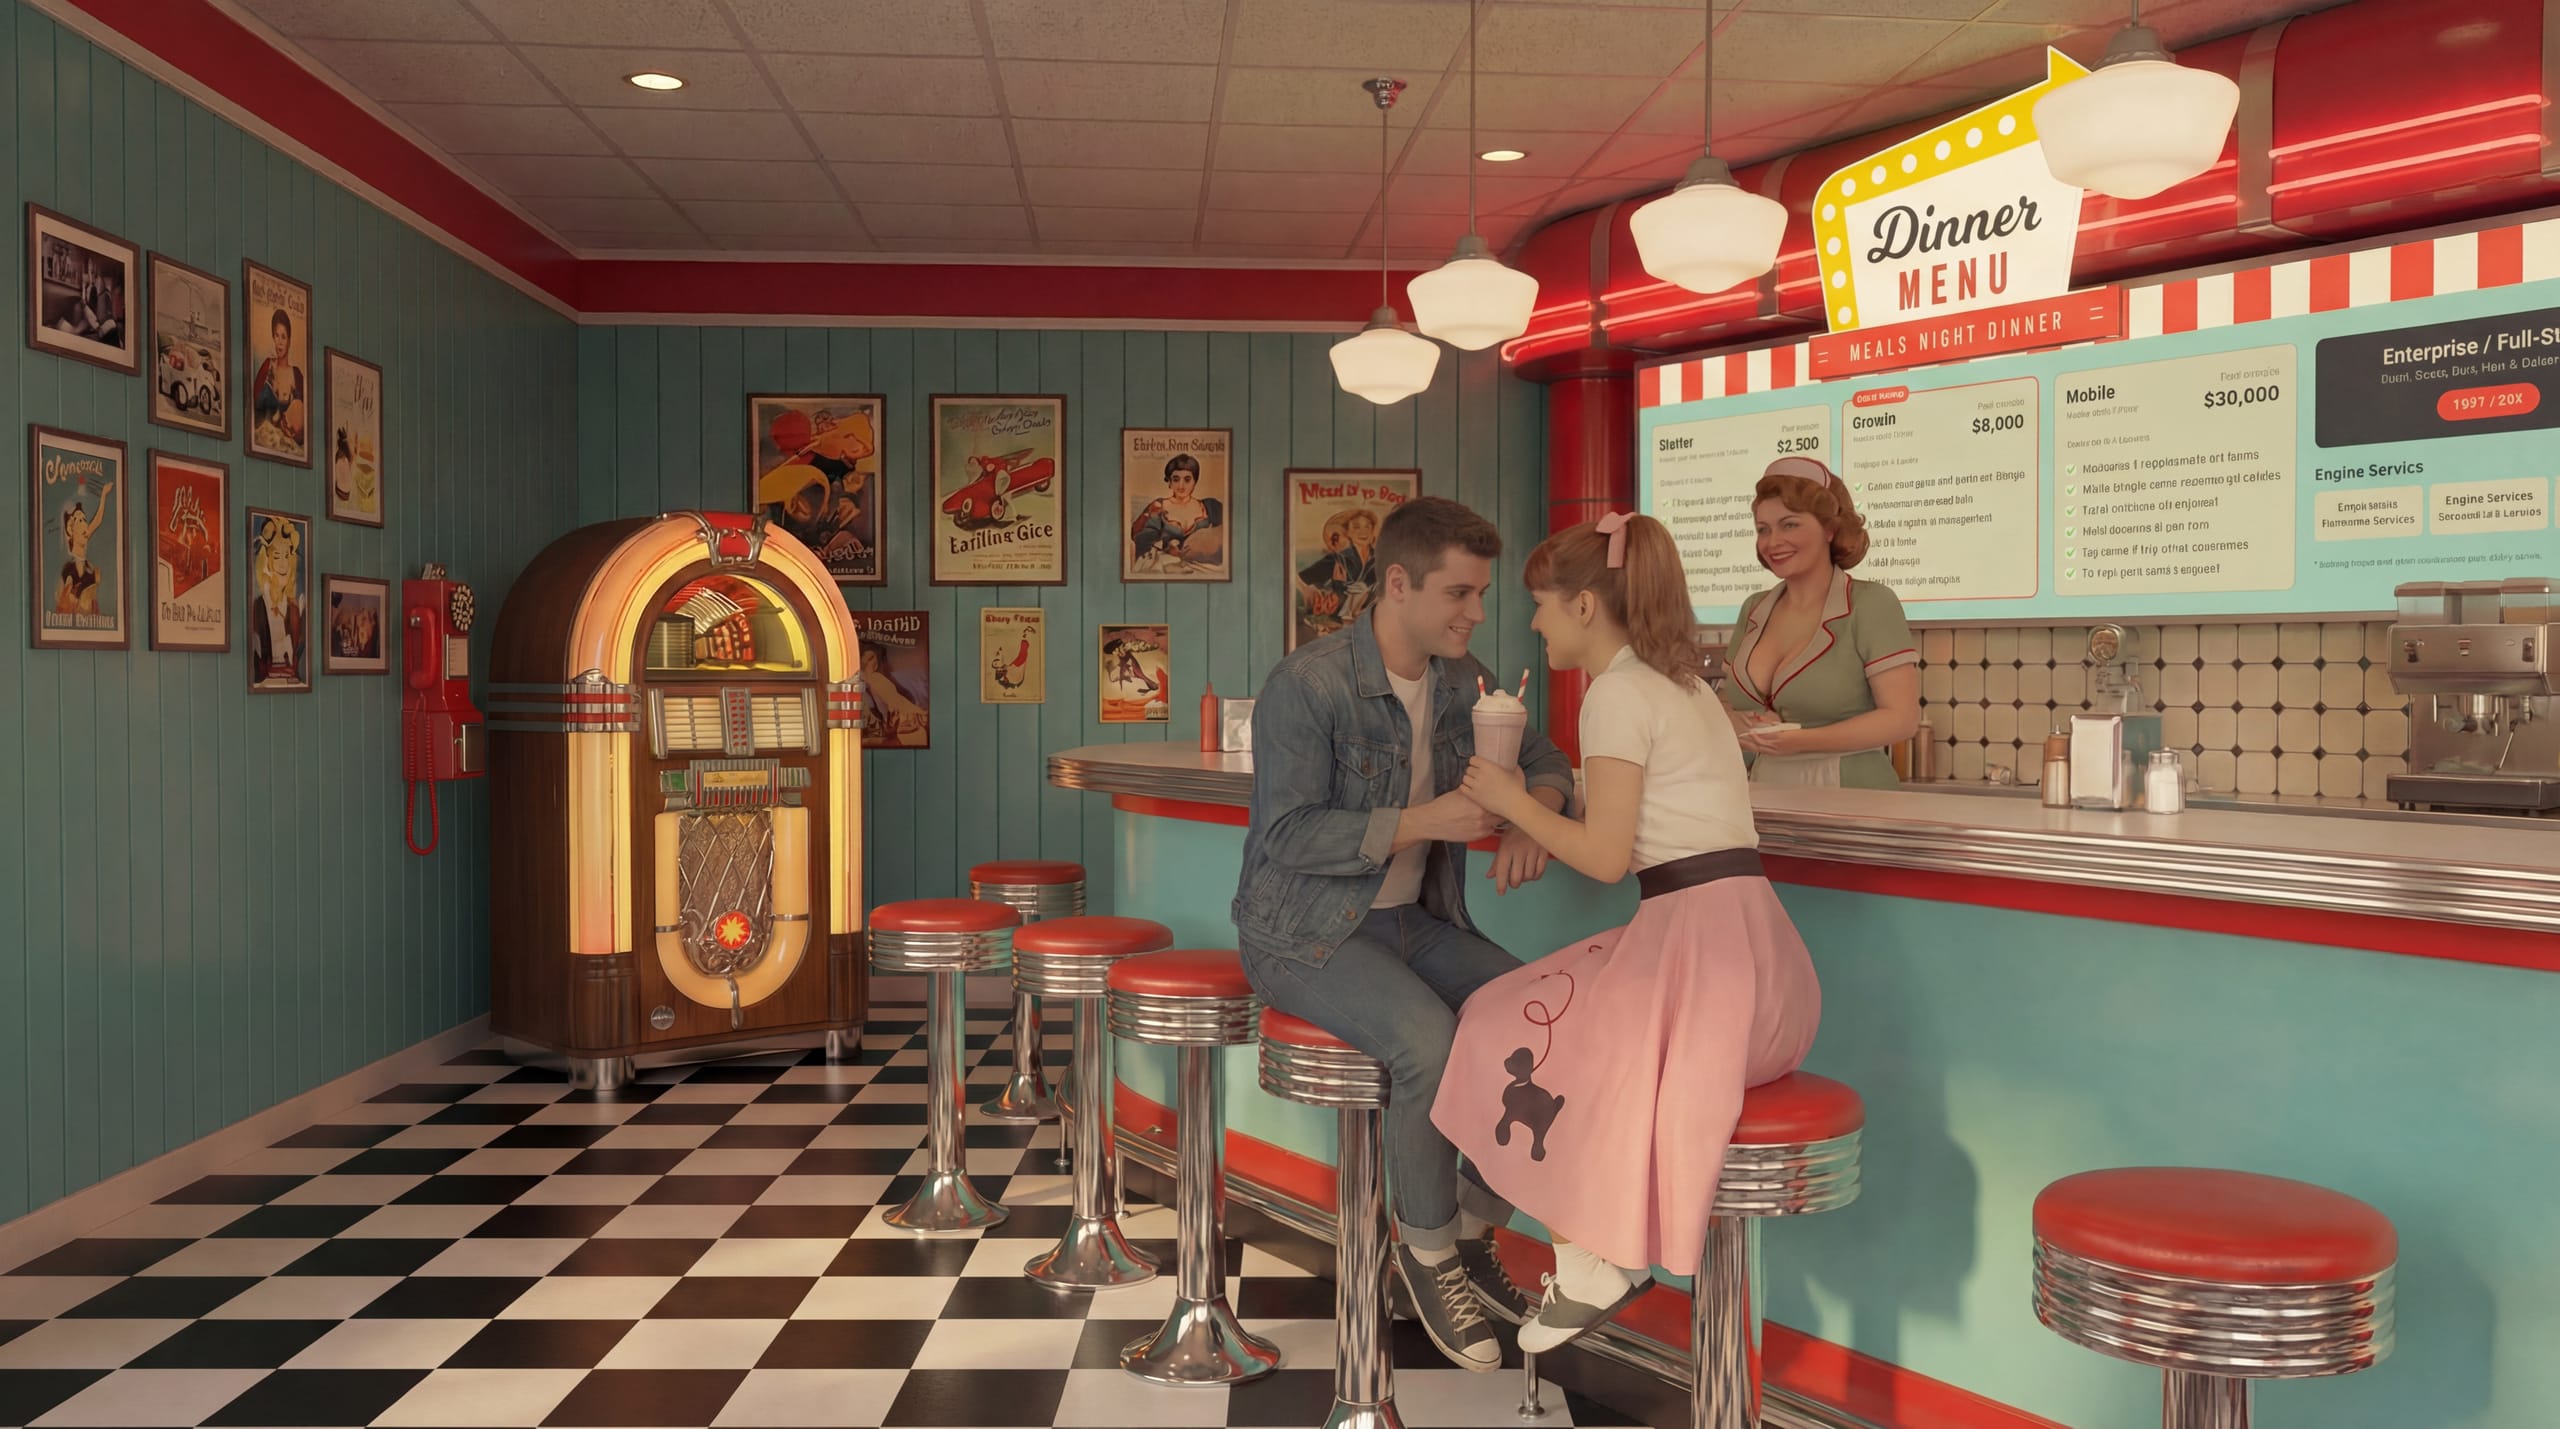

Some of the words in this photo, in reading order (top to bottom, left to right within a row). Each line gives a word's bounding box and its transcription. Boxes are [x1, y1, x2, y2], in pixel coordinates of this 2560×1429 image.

[1867, 195, 2042, 264] Dinner
[1898, 251, 2008, 311] MENU
[1849, 334, 1908, 362] MEALS
[1919, 323, 1976, 350] NIGHT
[1987, 311, 2063, 341] DINNER
[2383, 339, 2479, 366] Enterprise
[2483, 334, 2492, 355] /
[2066, 384, 2116, 405] Mobile
[2203, 385, 2280, 409] $30,000
[2453, 396, 2485, 411] 1997
[1971, 414, 2024, 435] $8,000
[2315, 465, 2365, 483] Engine
[2368, 461, 2424, 478] Servics
[2445, 494, 2485, 507] Engine
[2487, 490, 2534, 503] Services
[2373, 514, 2416, 526] Services
[1017, 523, 1054, 542] Gice
[2082, 567, 2094, 578] To
